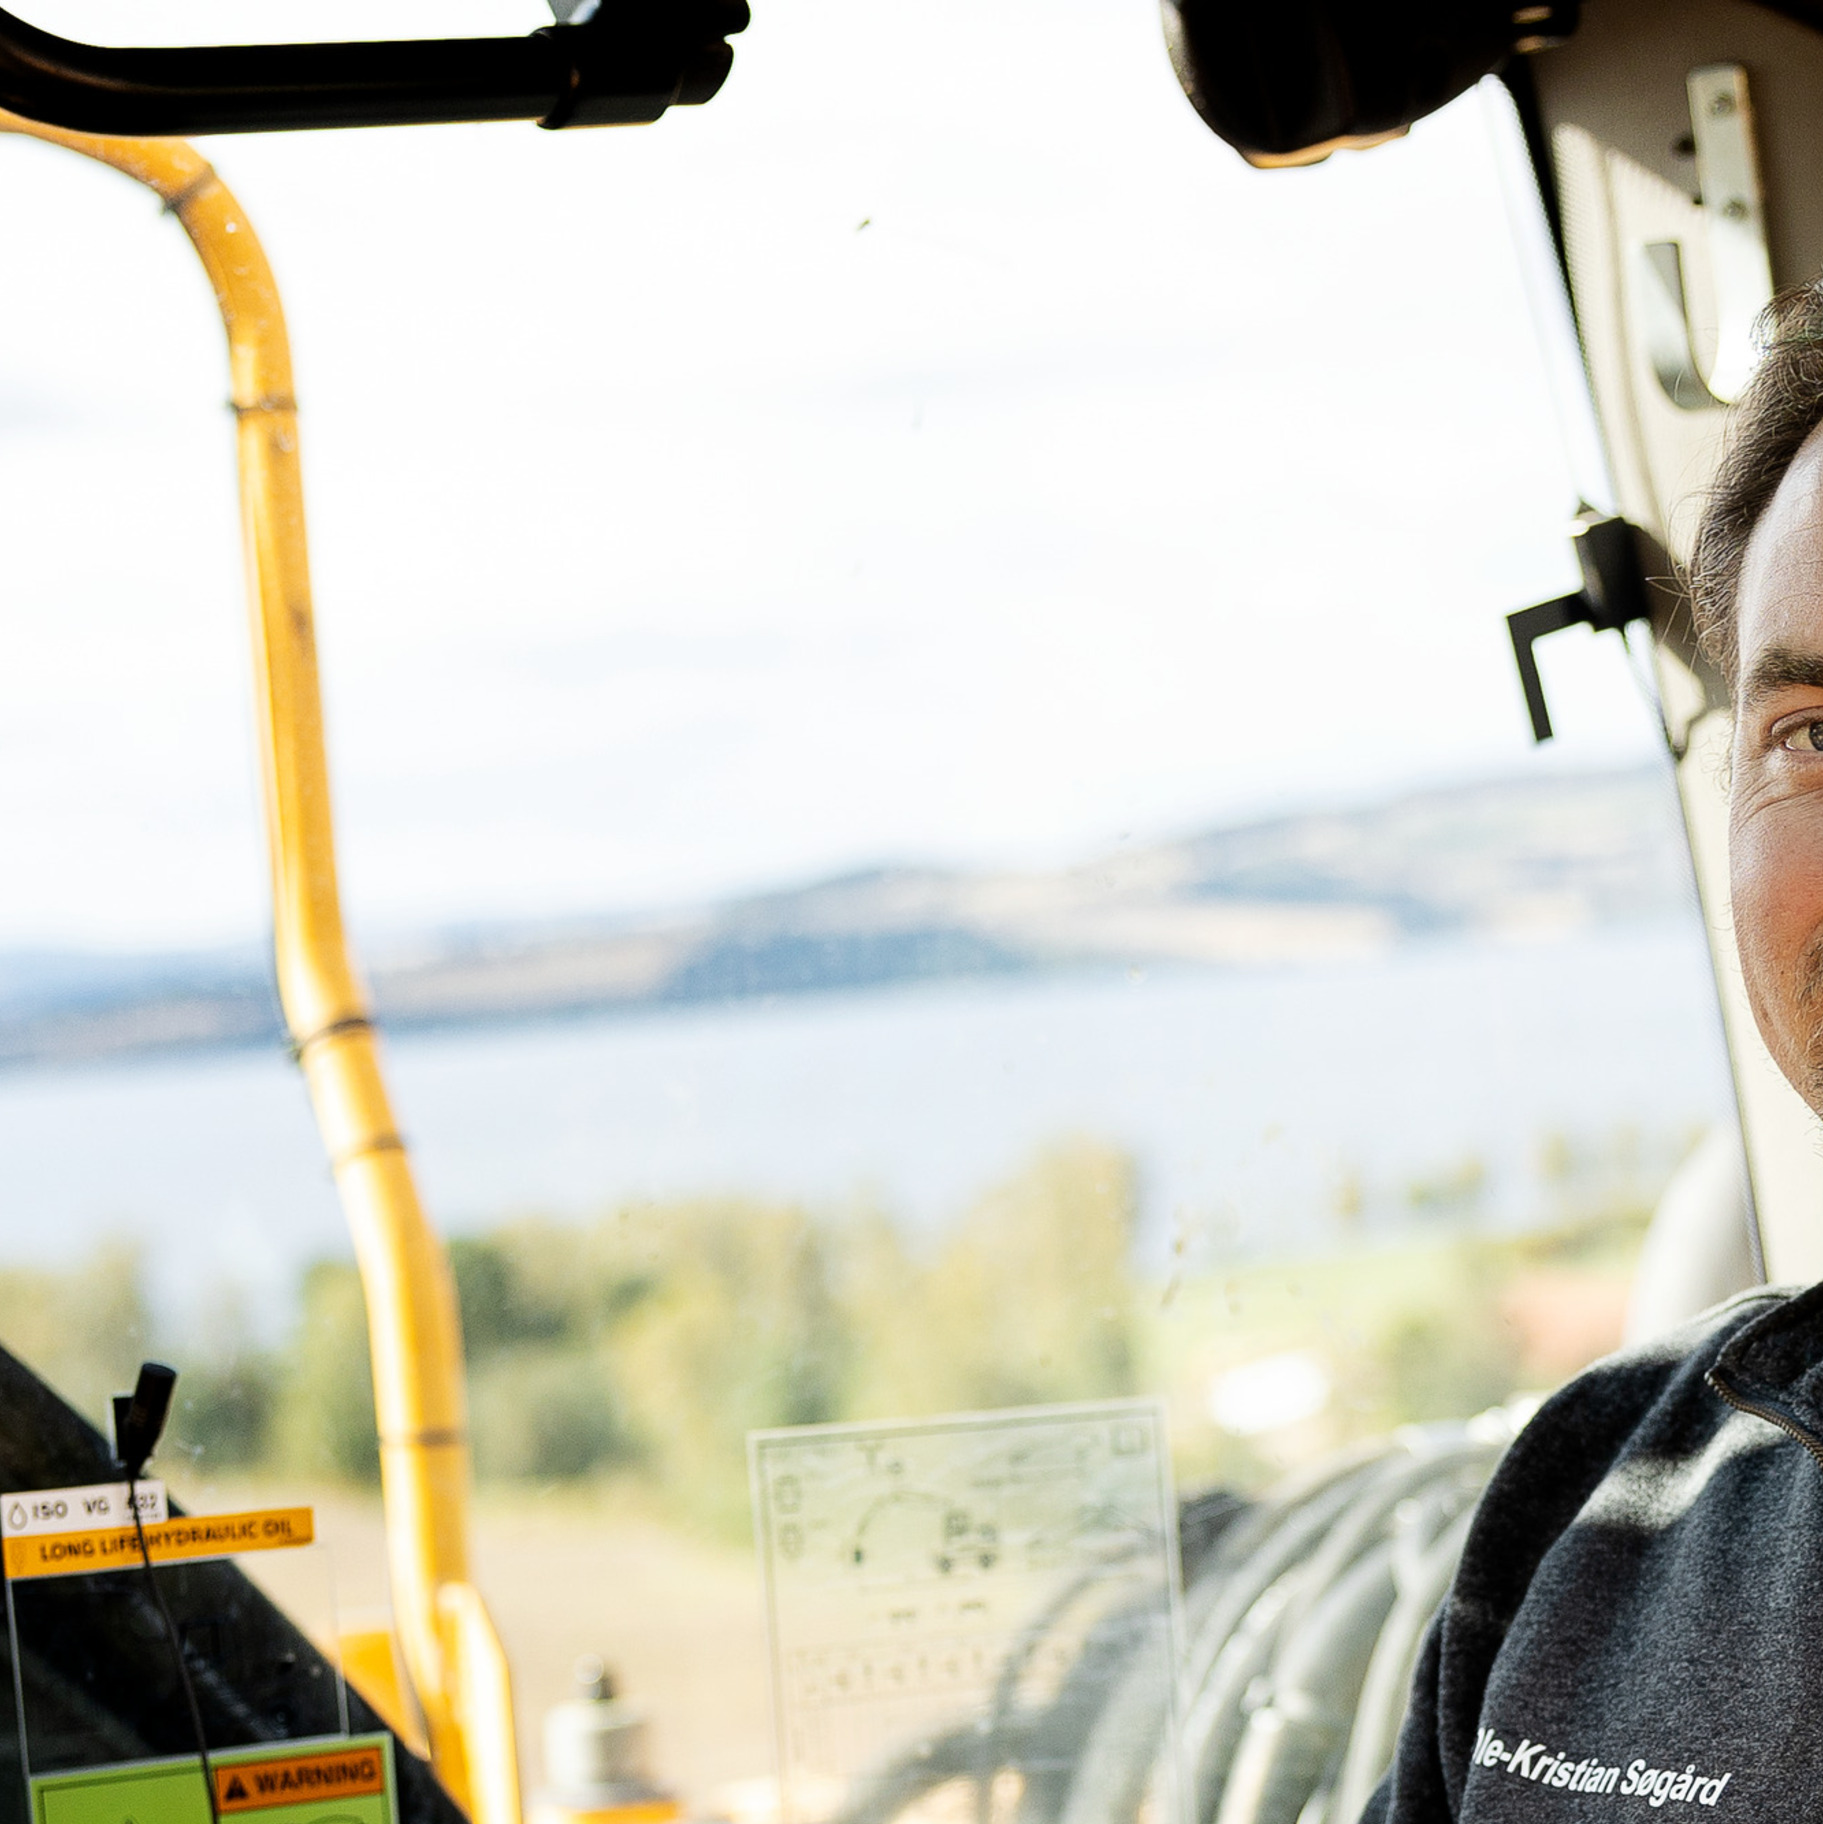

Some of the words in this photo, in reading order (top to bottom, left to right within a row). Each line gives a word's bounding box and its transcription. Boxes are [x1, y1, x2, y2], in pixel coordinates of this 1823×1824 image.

[40, 1540, 95, 1562] LONG
[262, 1518, 292, 1538] OIL
[255, 1757, 375, 1794] WARNING
[1620, 1758, 1732, 1807] Søgård
